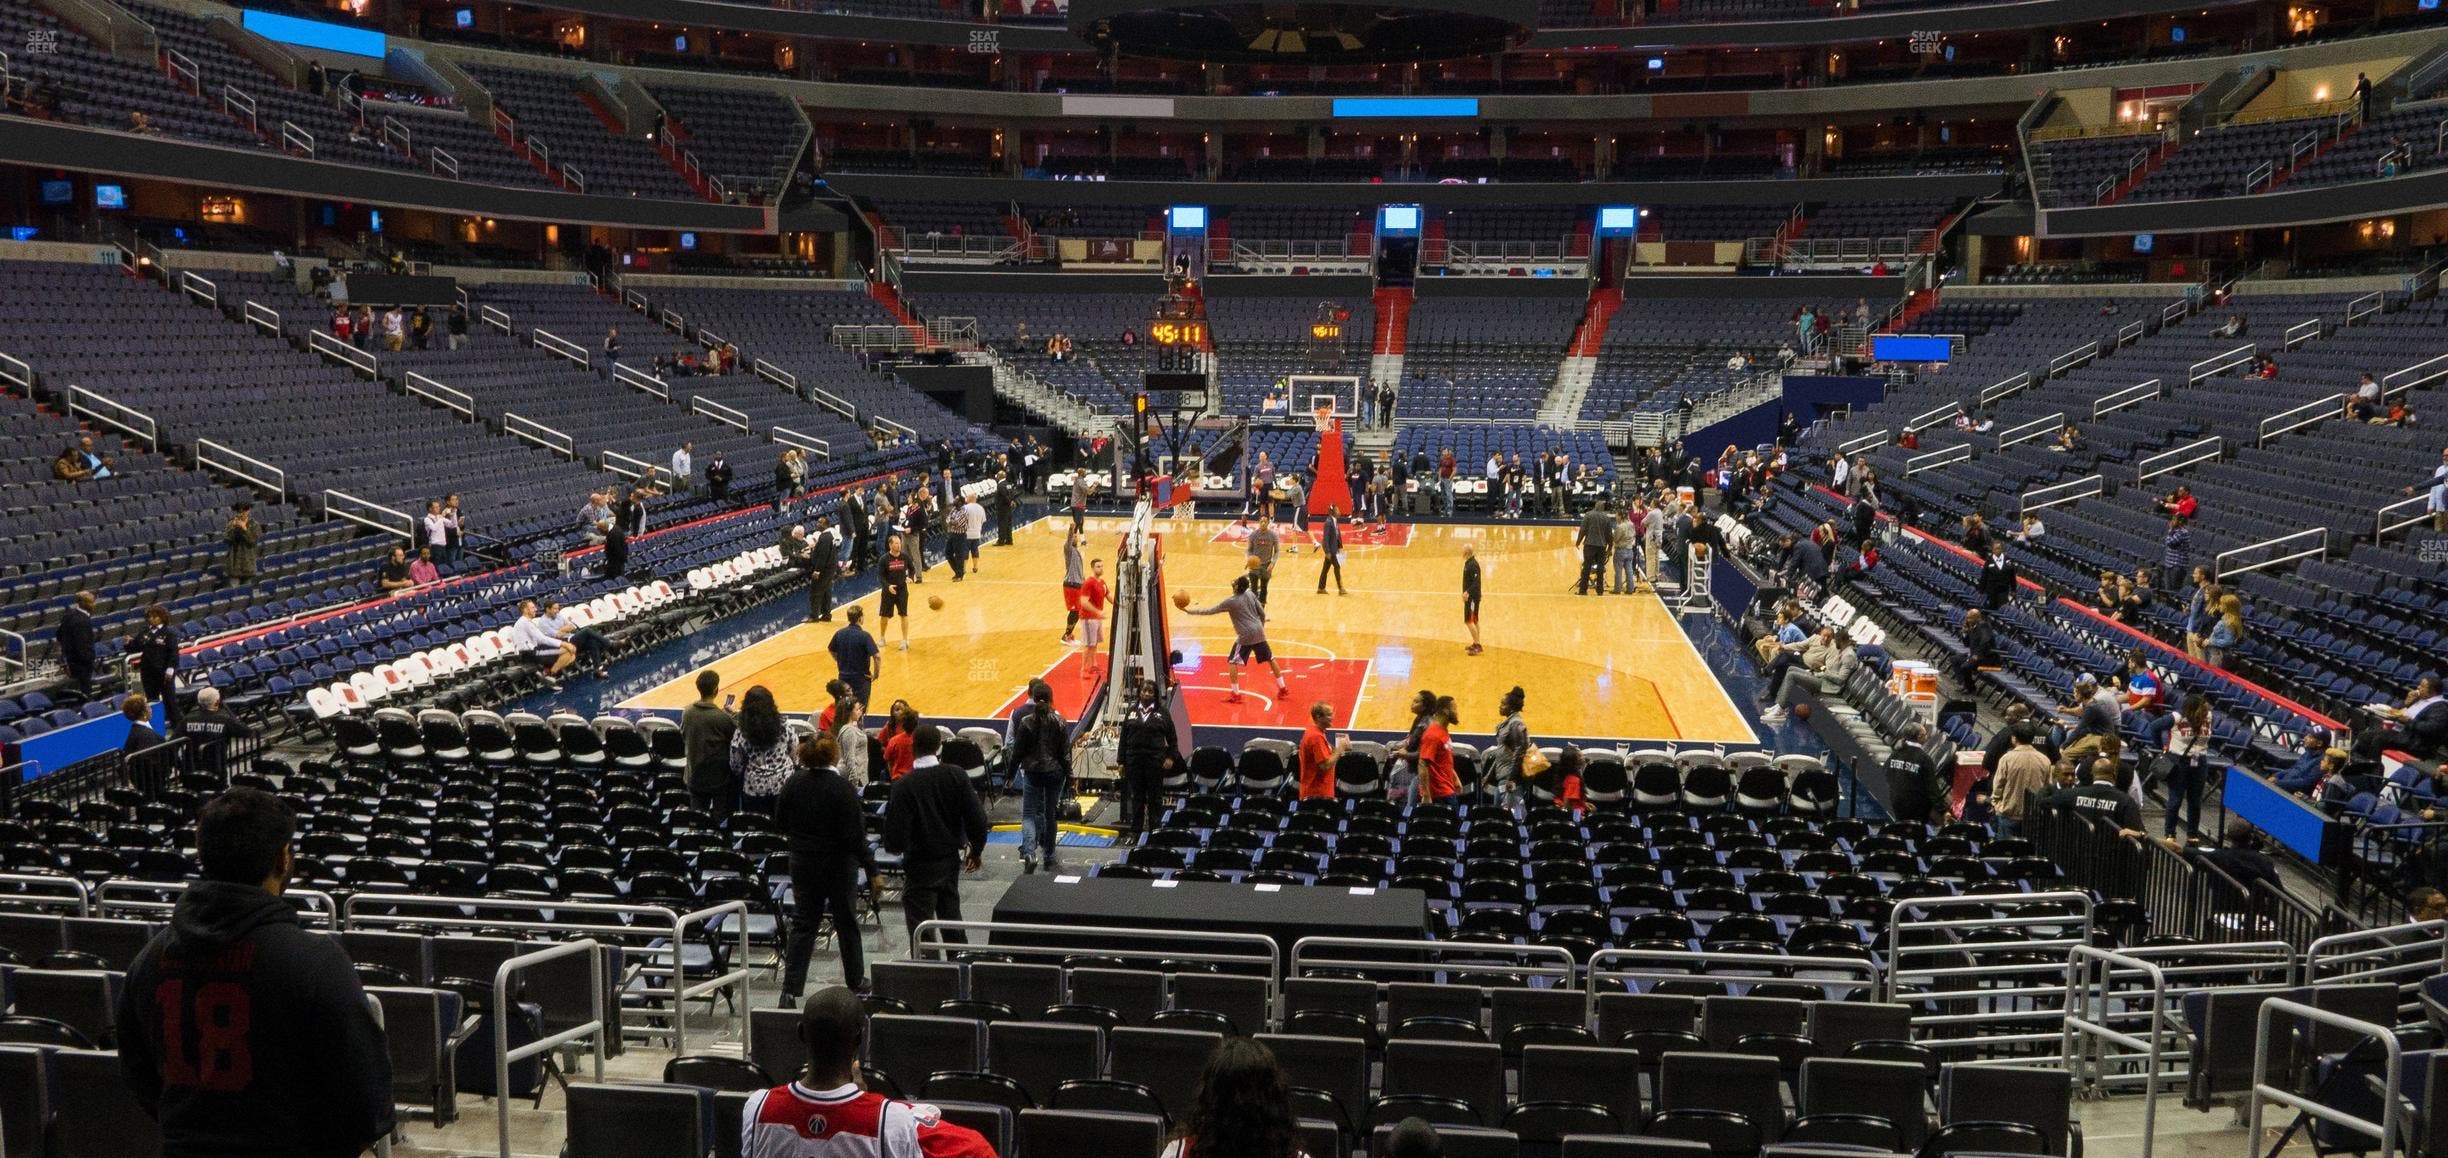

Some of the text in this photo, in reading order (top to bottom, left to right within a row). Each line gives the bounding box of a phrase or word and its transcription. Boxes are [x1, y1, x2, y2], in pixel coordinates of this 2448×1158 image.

[101, 251, 116, 262] 111
[1152, 324, 1201, 345] 45:11
[1312, 326, 1339, 340] 45:11
[186, 722, 225, 734] EVENT STAFF
[1890, 759, 1920, 774] EVENT STAFF
[2076, 796, 2118, 811] EVENT STAFF
[154, 978, 255, 1094] 18
